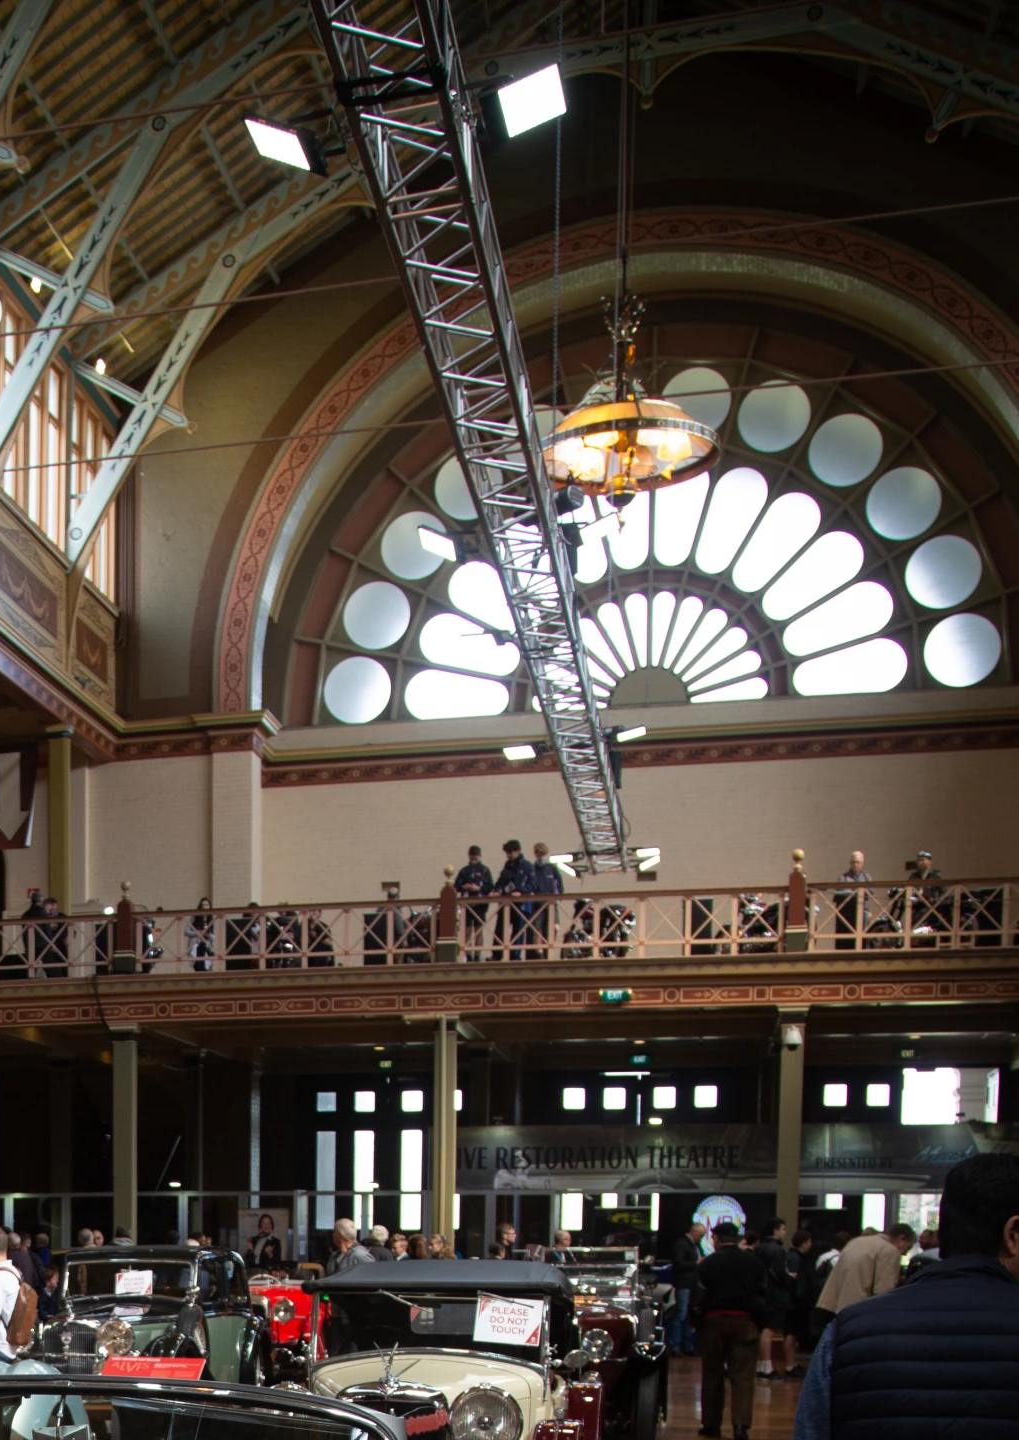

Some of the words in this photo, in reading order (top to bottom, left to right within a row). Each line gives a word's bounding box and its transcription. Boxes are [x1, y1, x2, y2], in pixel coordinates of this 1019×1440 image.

[607, 990, 623, 1000] EXIT
[379, 1060, 392, 1068] EXIT
[633, 1055, 646, 1063] EXIT
[458, 1147, 488, 1169] IVE
[495, 1146, 638, 1169] RESTORATION
[647, 1146, 740, 1169] THEATRE
[815, 1156, 876, 1169] PRESENTED
[492, 1306, 529, 1316] PLEASE
[490, 1316, 504, 1324] DO
[508, 1317, 529, 1326] NOT
[491, 1325, 525, 1335] TOUCH
[112, 1362, 150, 1373] ALVIS
